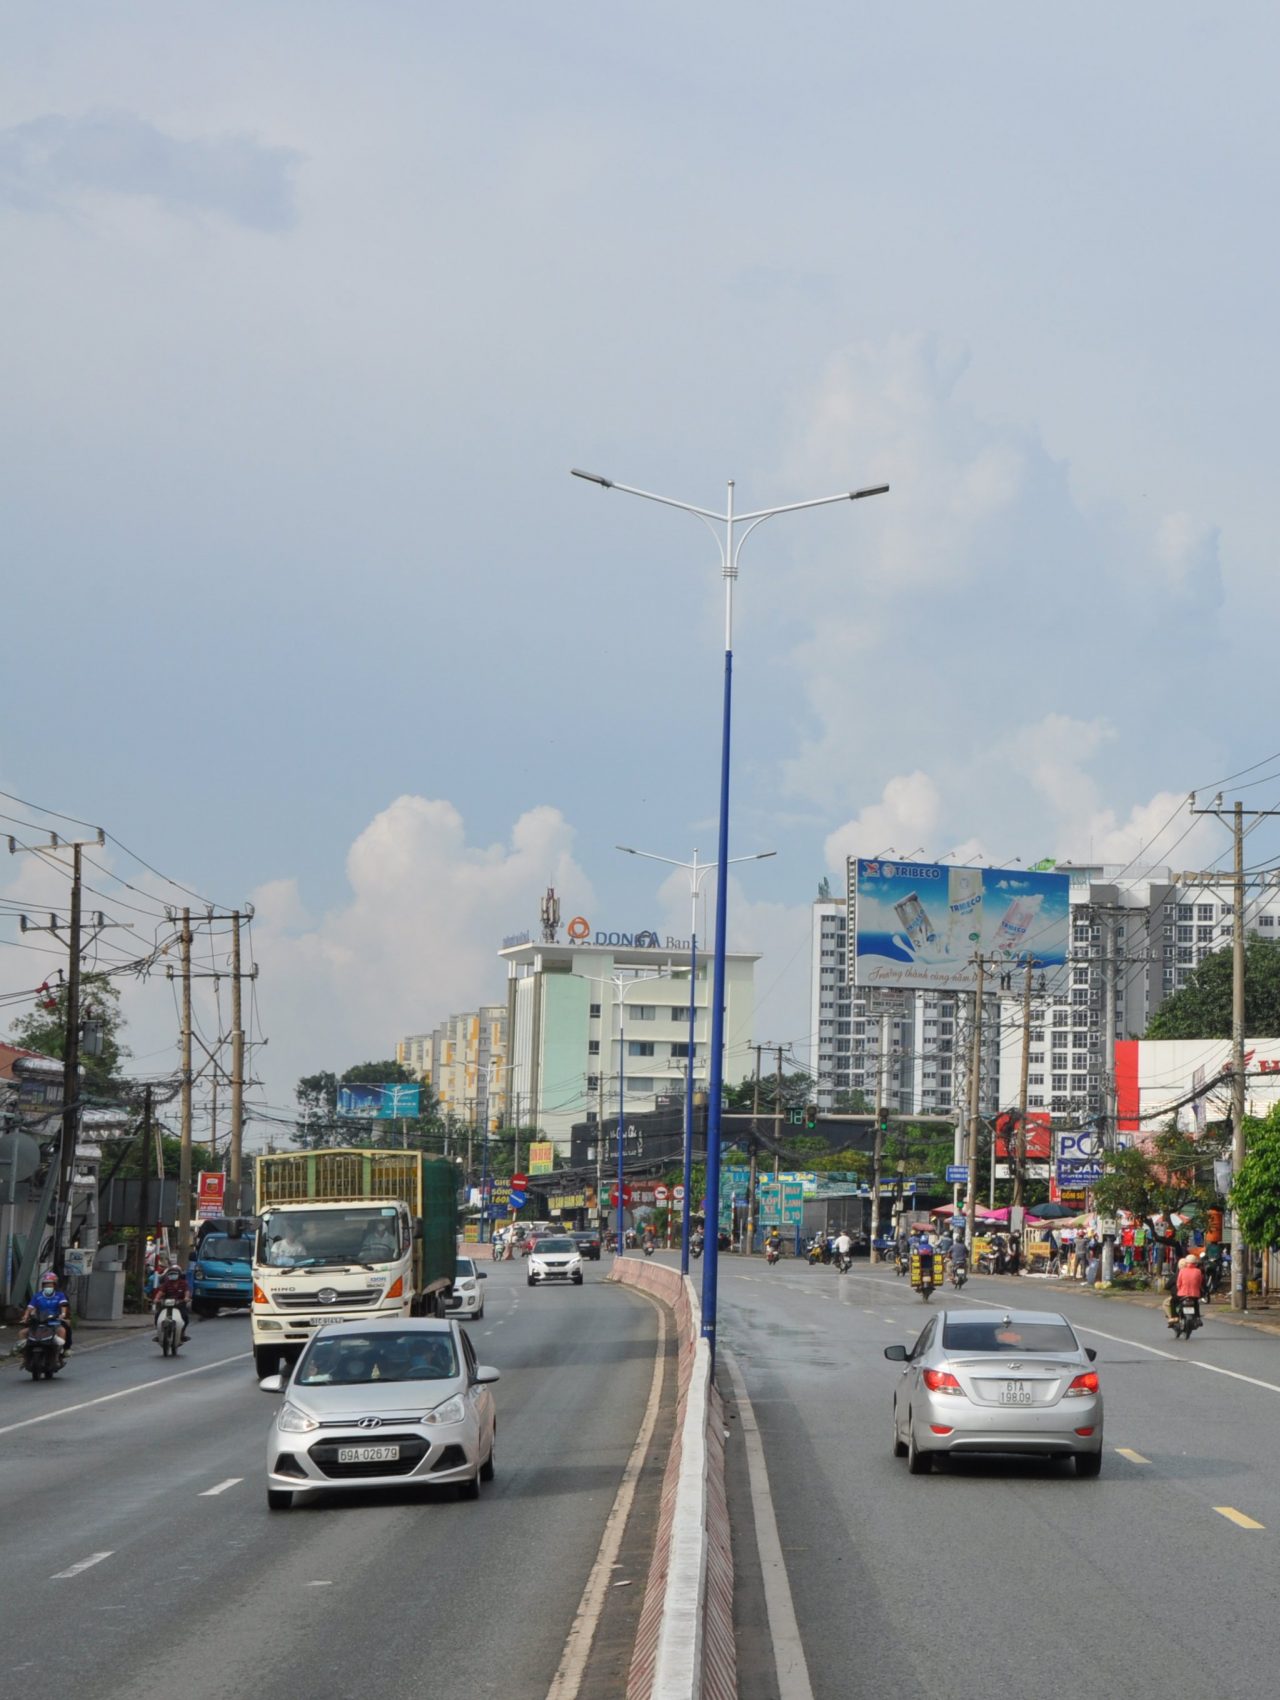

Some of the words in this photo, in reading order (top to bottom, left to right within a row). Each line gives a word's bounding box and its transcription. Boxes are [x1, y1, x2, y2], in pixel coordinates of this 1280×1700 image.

[895, 865, 941, 879] TRIBECO
[950, 895, 982, 914] TRIBECO
[1006, 1381, 1024, 1392] 61A
